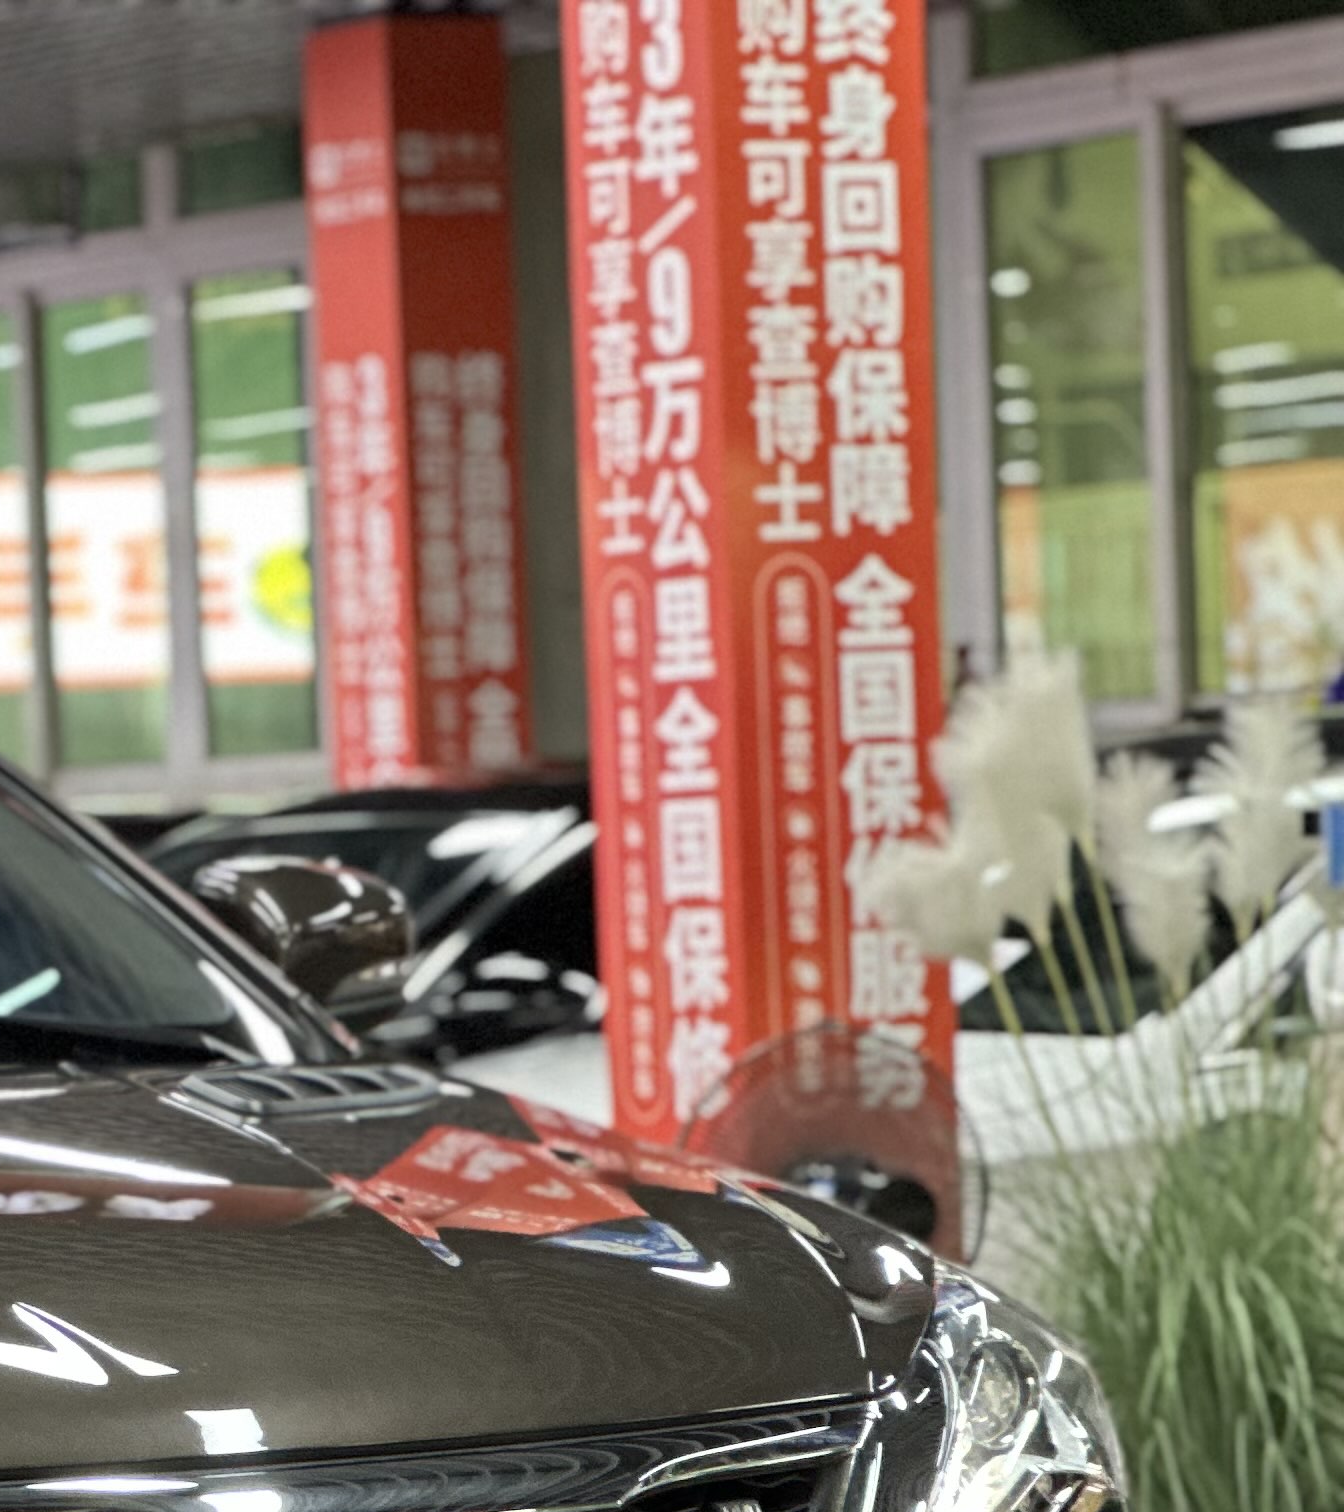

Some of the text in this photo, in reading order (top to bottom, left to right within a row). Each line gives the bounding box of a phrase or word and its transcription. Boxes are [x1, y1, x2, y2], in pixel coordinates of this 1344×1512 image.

[814, 0, 912, 537] 终身回购保障
